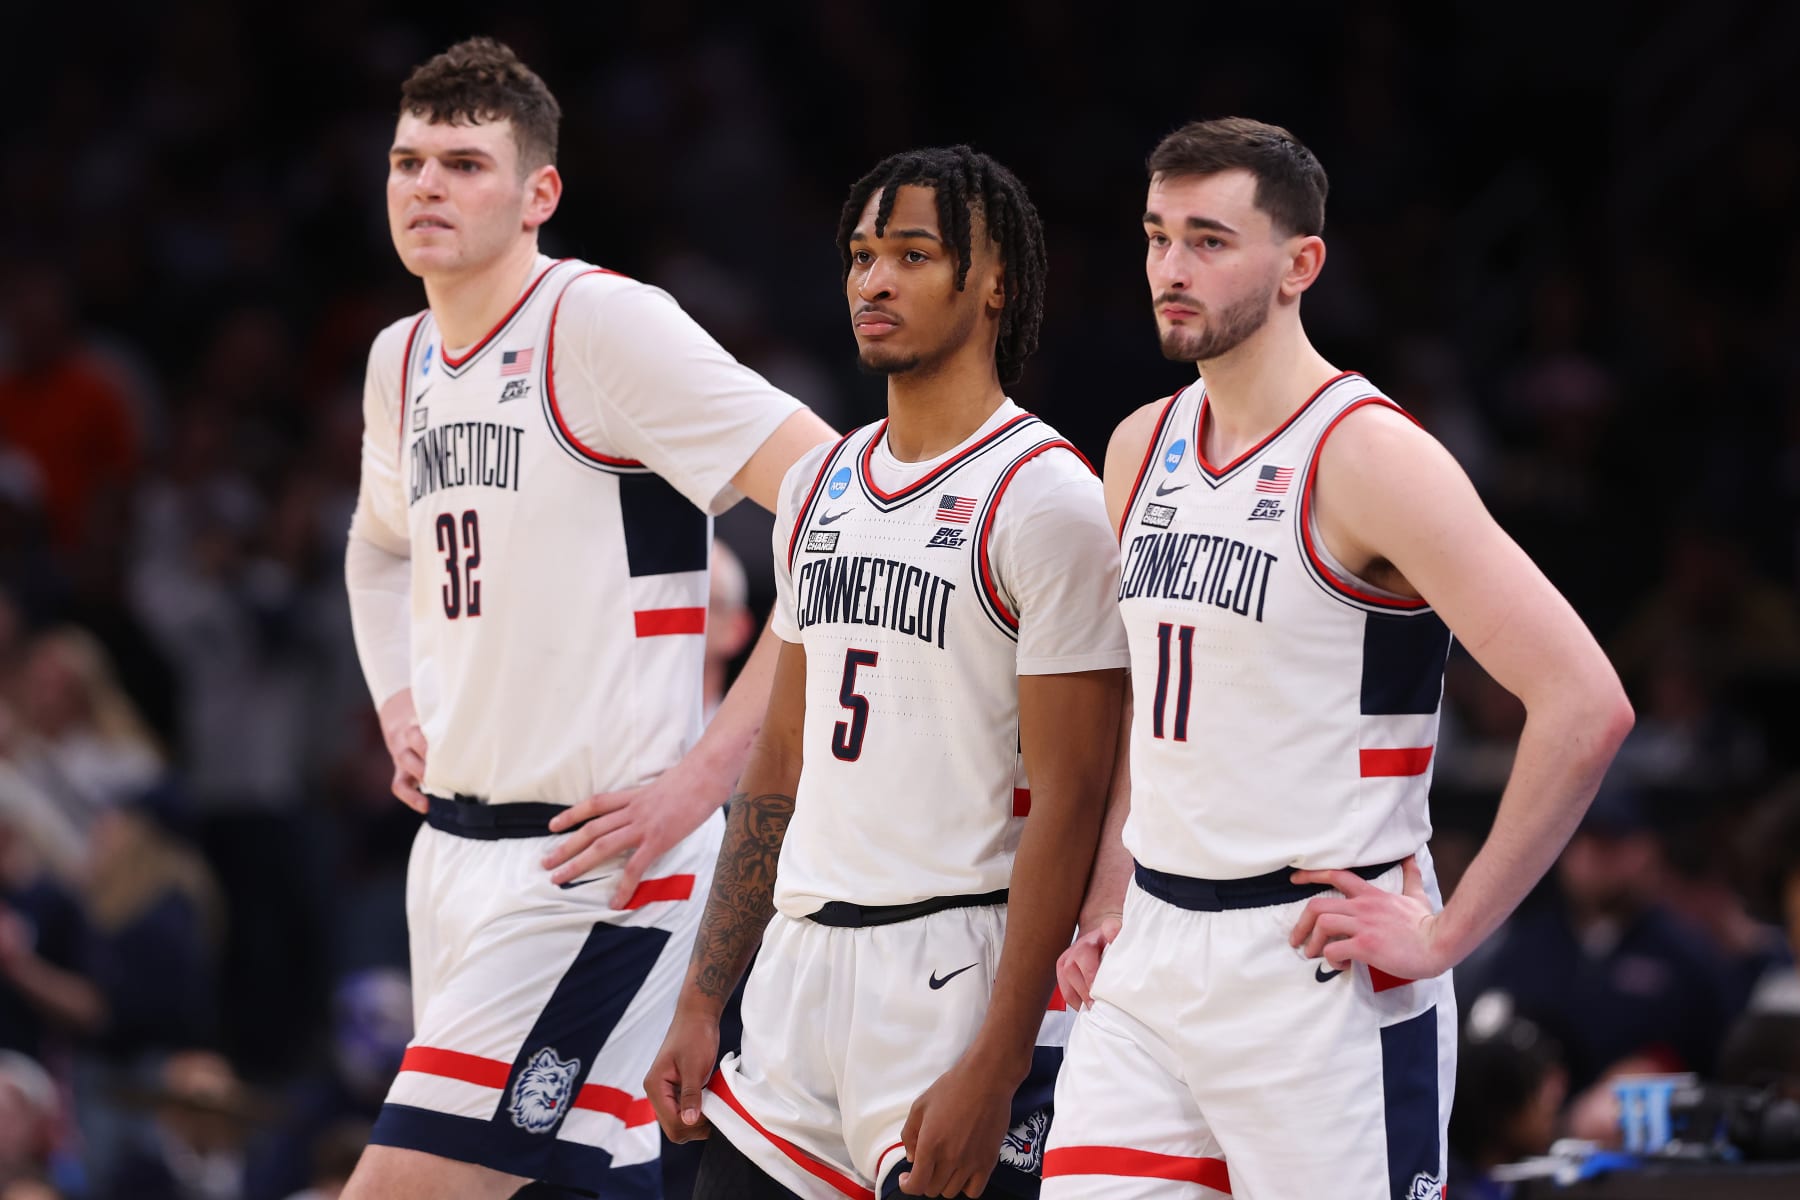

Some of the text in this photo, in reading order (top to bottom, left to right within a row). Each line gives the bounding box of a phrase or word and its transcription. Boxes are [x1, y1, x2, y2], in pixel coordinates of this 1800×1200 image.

[930, 536, 967, 546] EAST
[936, 527, 963, 537] BIG
[1251, 508, 1285, 518] EAST
[1257, 499, 1280, 508] BIG
[436, 509, 481, 620] 32
[798, 556, 956, 649] CONNECTICUT
[1118, 533, 1278, 622] CONNECTICUT
[831, 648, 878, 762] 5
[1153, 622, 1195, 741] 11
